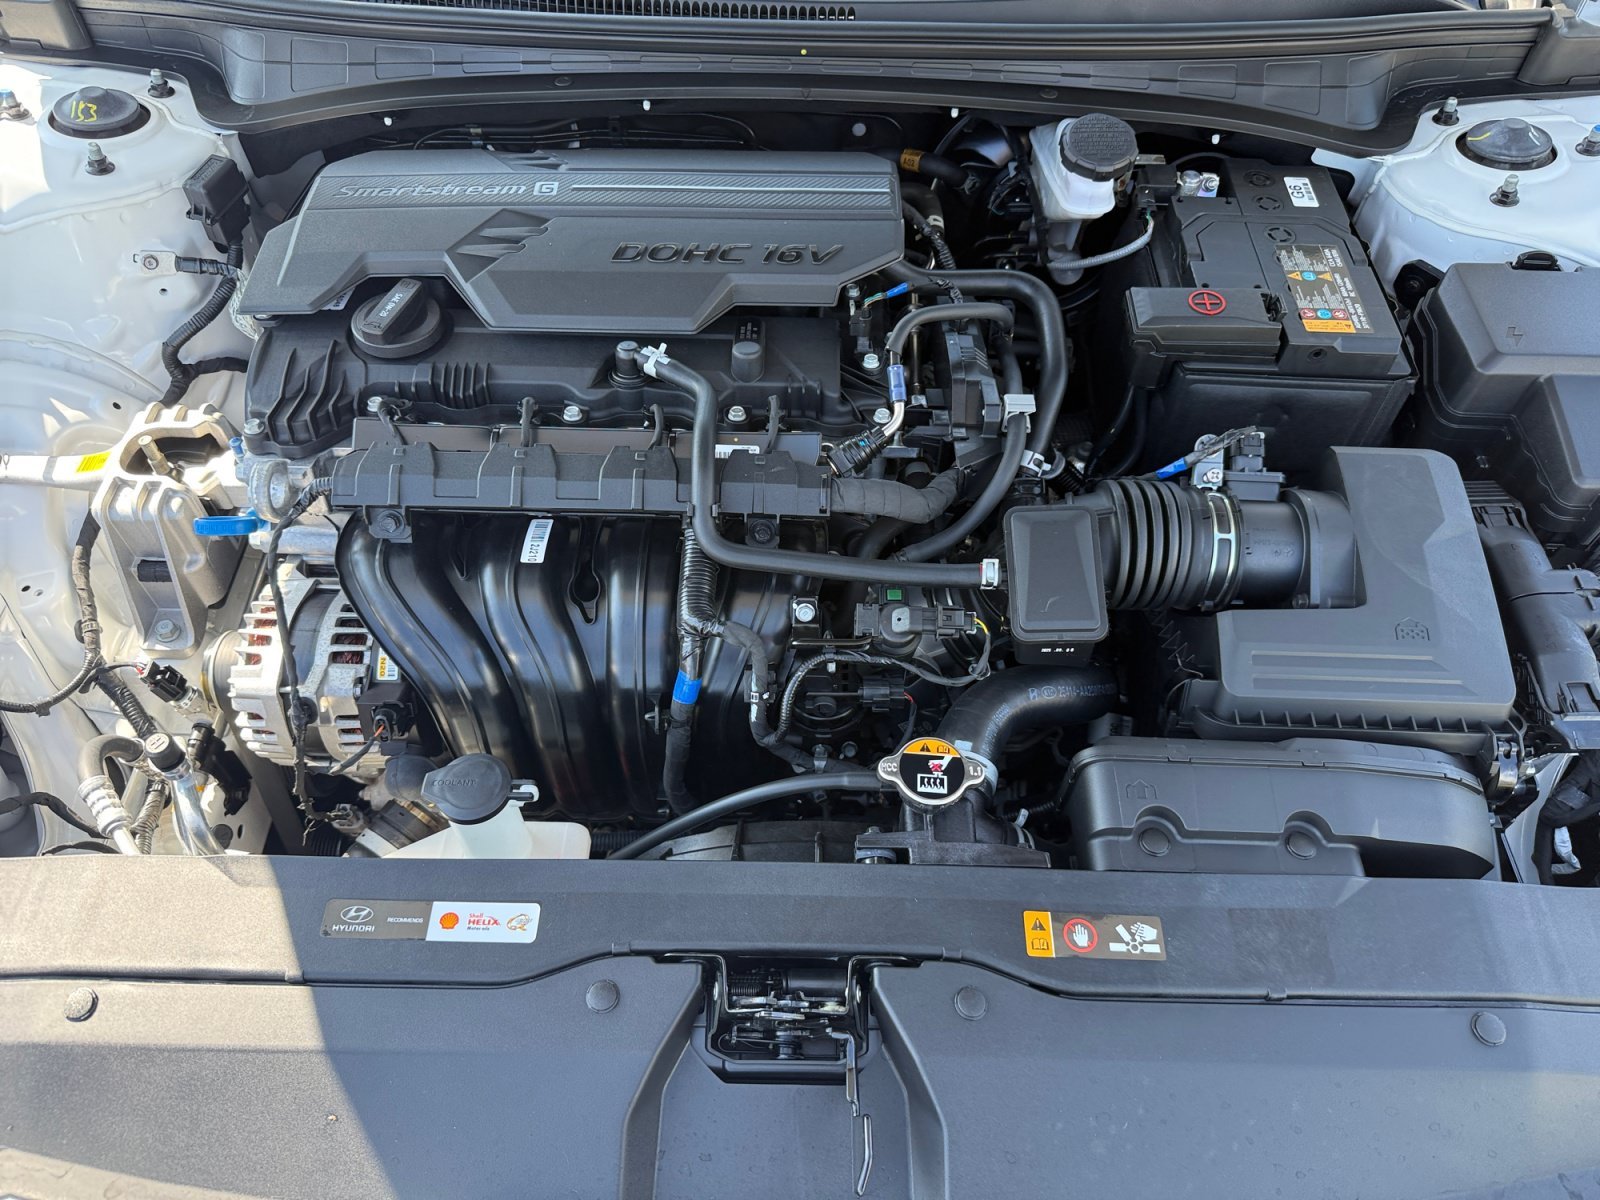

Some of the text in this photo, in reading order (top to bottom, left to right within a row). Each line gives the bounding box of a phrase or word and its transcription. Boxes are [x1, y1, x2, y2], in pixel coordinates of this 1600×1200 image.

[333, 184, 528, 198] Smartstream
[1289, 185, 1305, 198] G6
[610, 241, 844, 265] DOHC 16V
[528, 543, 541, 562] 2J210
[881, 762, 898, 772] HCC
[968, 766, 982, 776] 1.1
[432, 779, 476, 787] COOLANT
[467, 918, 499, 926] HELIX
[332, 924, 375, 932] HYUNDAI
